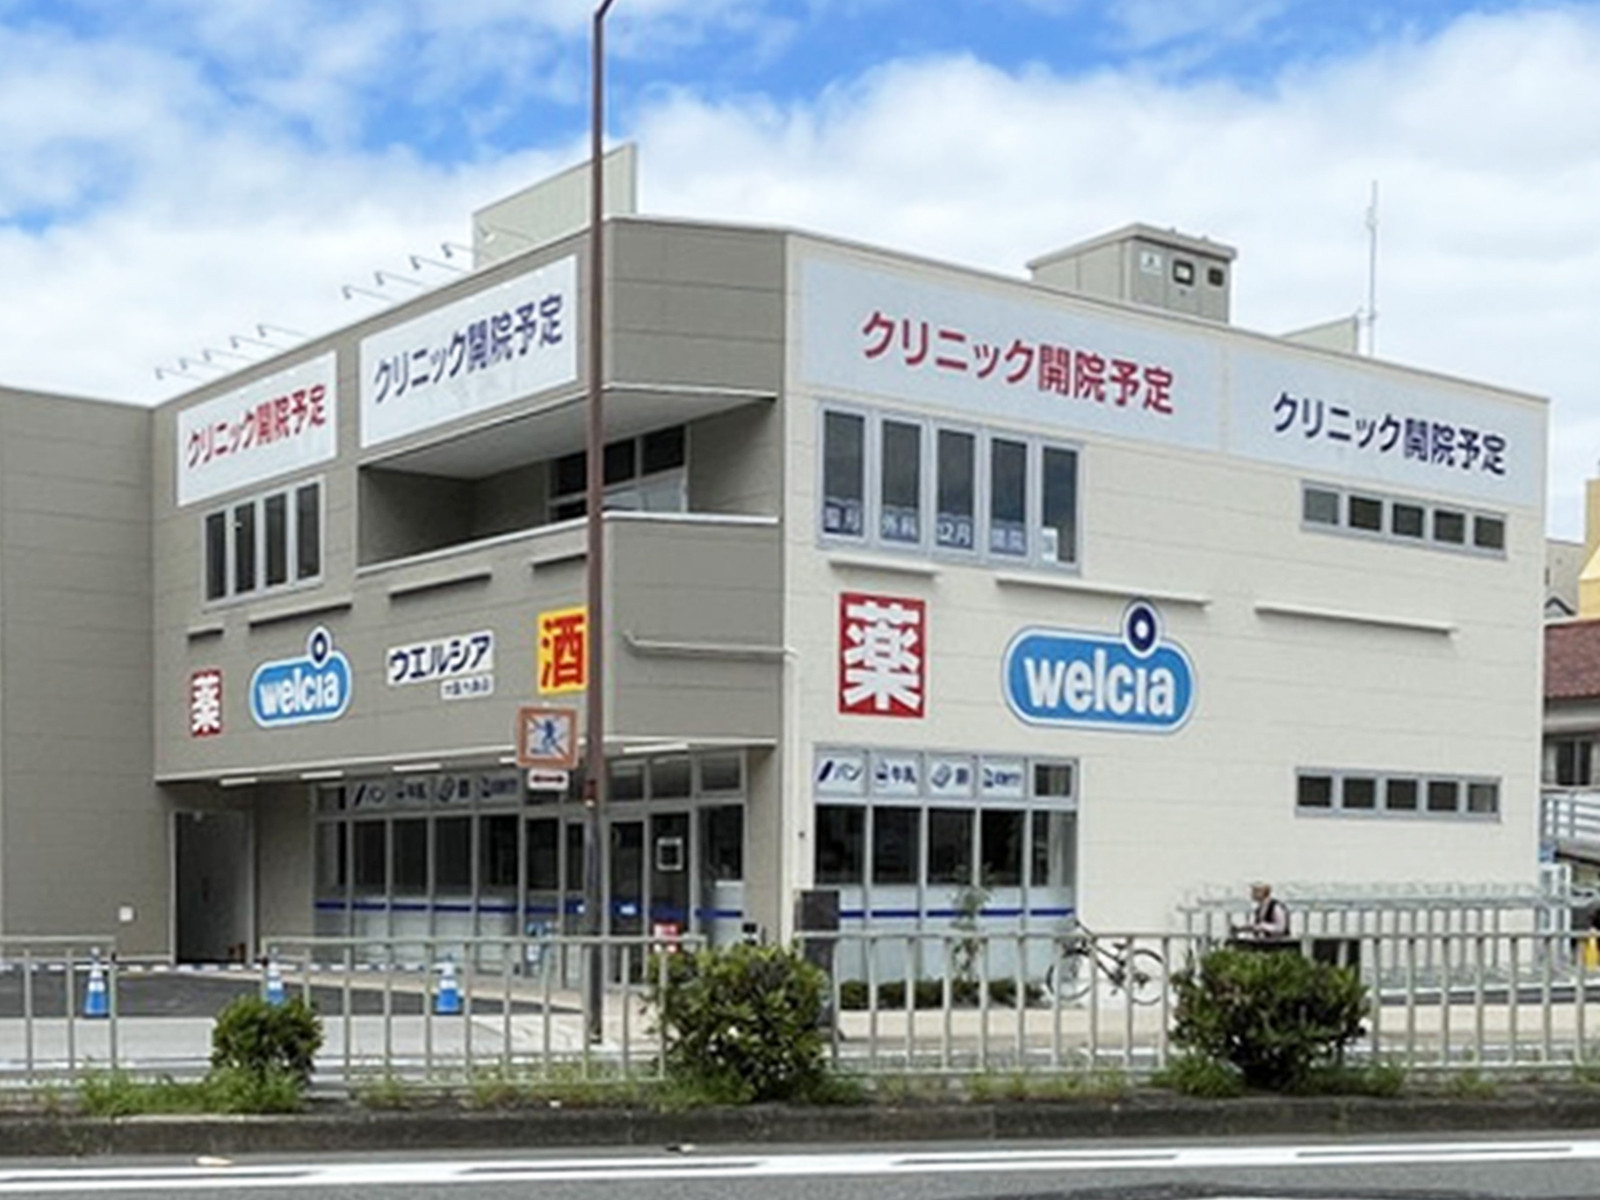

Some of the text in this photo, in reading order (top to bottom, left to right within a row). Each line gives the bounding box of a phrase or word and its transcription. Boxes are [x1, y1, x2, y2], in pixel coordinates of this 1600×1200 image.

[374, 294, 563, 403] クリニック開院予定
[862, 311, 1174, 415] クリニック開院予定
[187, 383, 327, 469] クリニック開院予定
[1274, 391, 1506, 476] クリニック開院予定
[258, 631, 341, 717] welcia
[390, 634, 491, 682] ウエルシア
[541, 613, 585, 688] 酒
[843, 600, 921, 712] 薬
[1023, 603, 1177, 717] welcia
[191, 674, 220, 733] 薬
